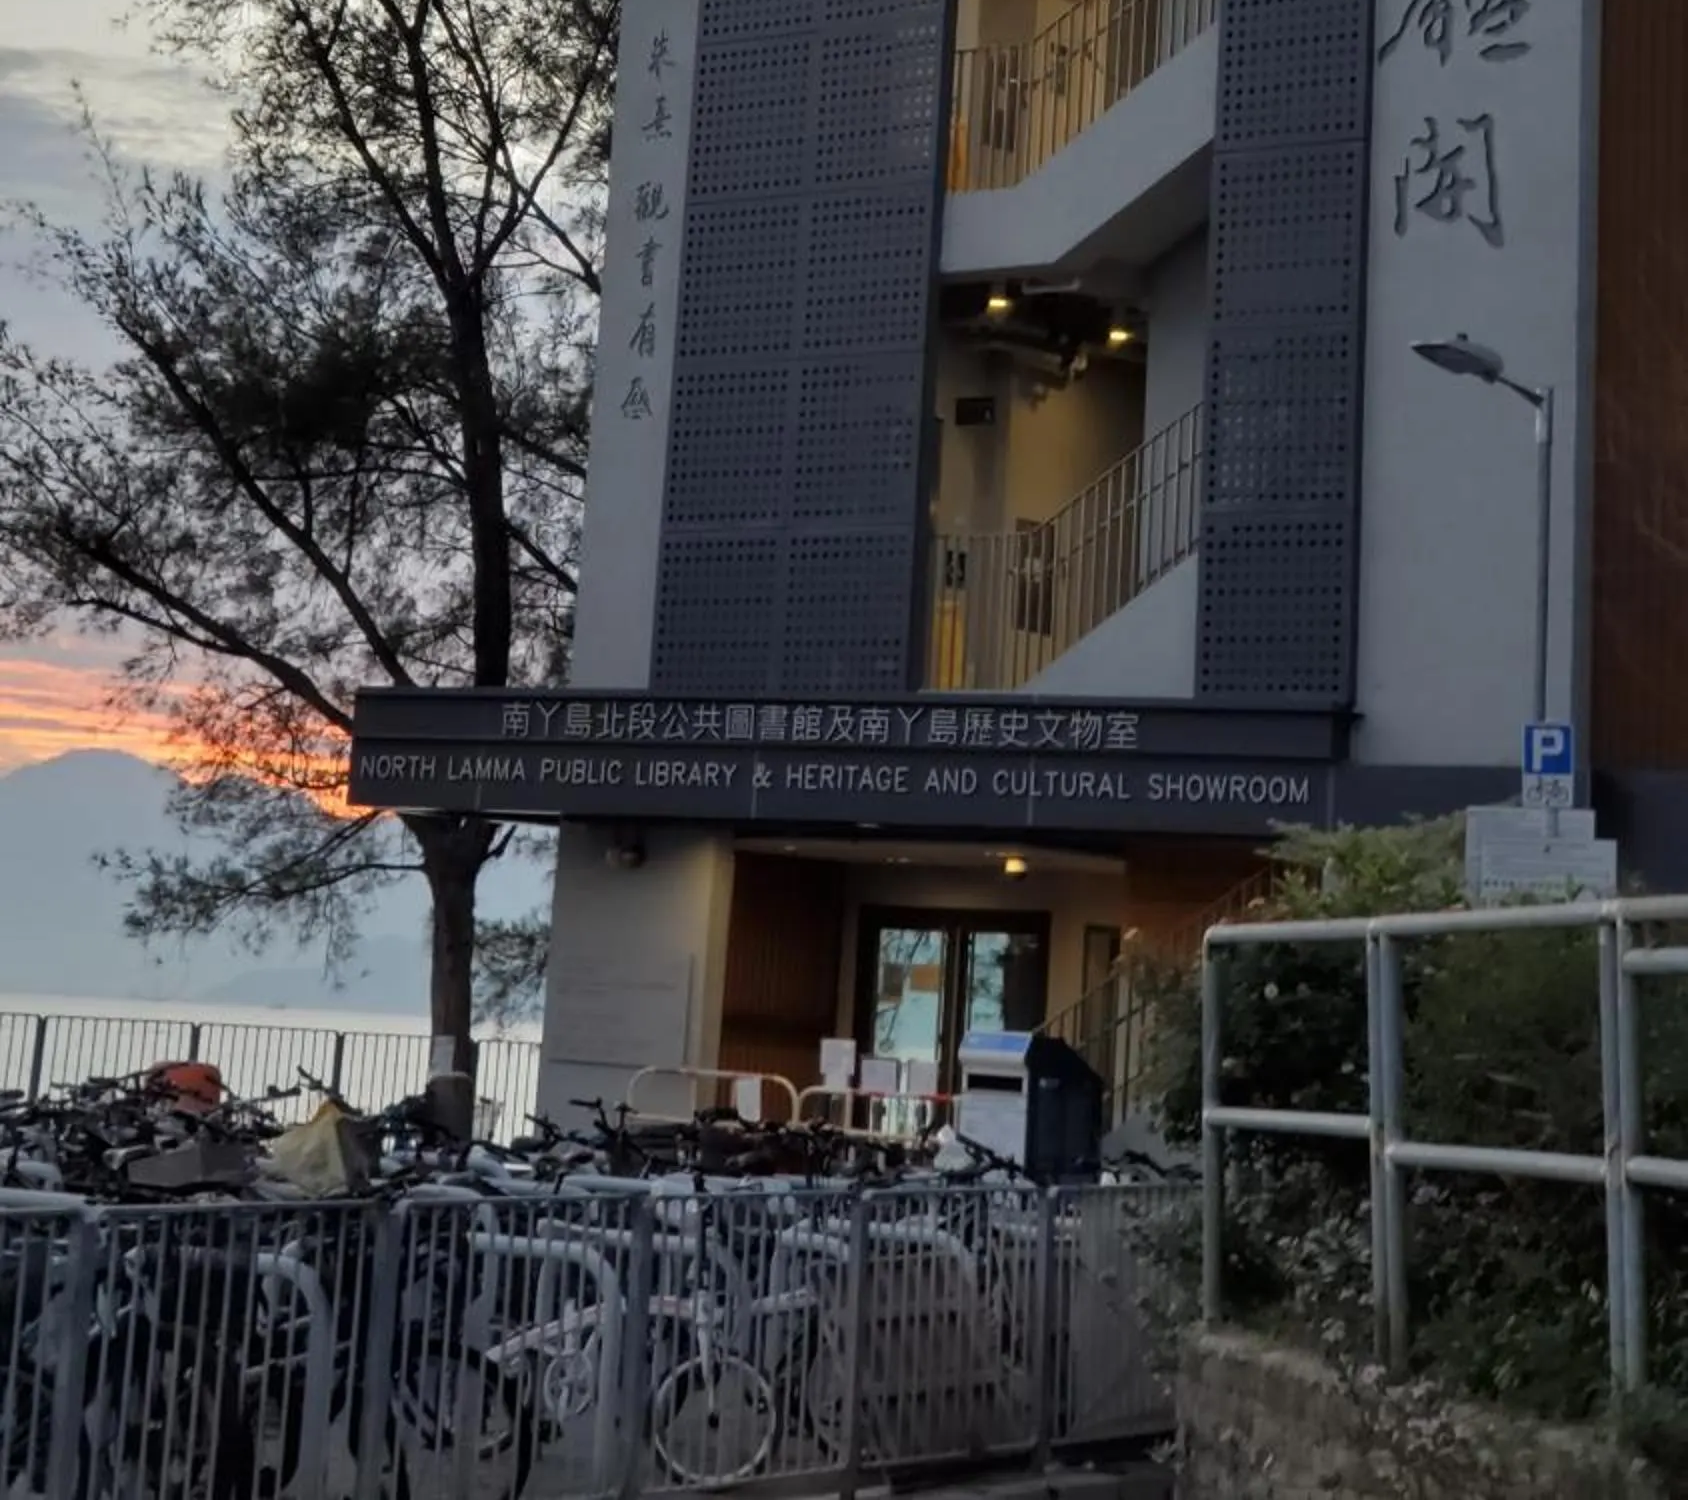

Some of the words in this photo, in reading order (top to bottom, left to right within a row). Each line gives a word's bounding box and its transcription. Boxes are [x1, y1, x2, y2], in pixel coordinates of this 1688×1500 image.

[501, 701, 1140, 750] 南丫島北段公共圖書館及南丫島歷史文物室
[1531, 728, 1565, 773] P
[360, 754, 436, 780] NORTH
[447, 757, 526, 783] LAMMA
[539, 758, 622, 786] PUBLIC
[634, 762, 737, 789] LIBRARY
[751, 764, 771, 789] &
[786, 763, 909, 791] HERITAGE
[924, 766, 978, 794] AND
[992, 769, 1132, 799] CULTURAL
[1147, 772, 1310, 805] SHOWROOM
